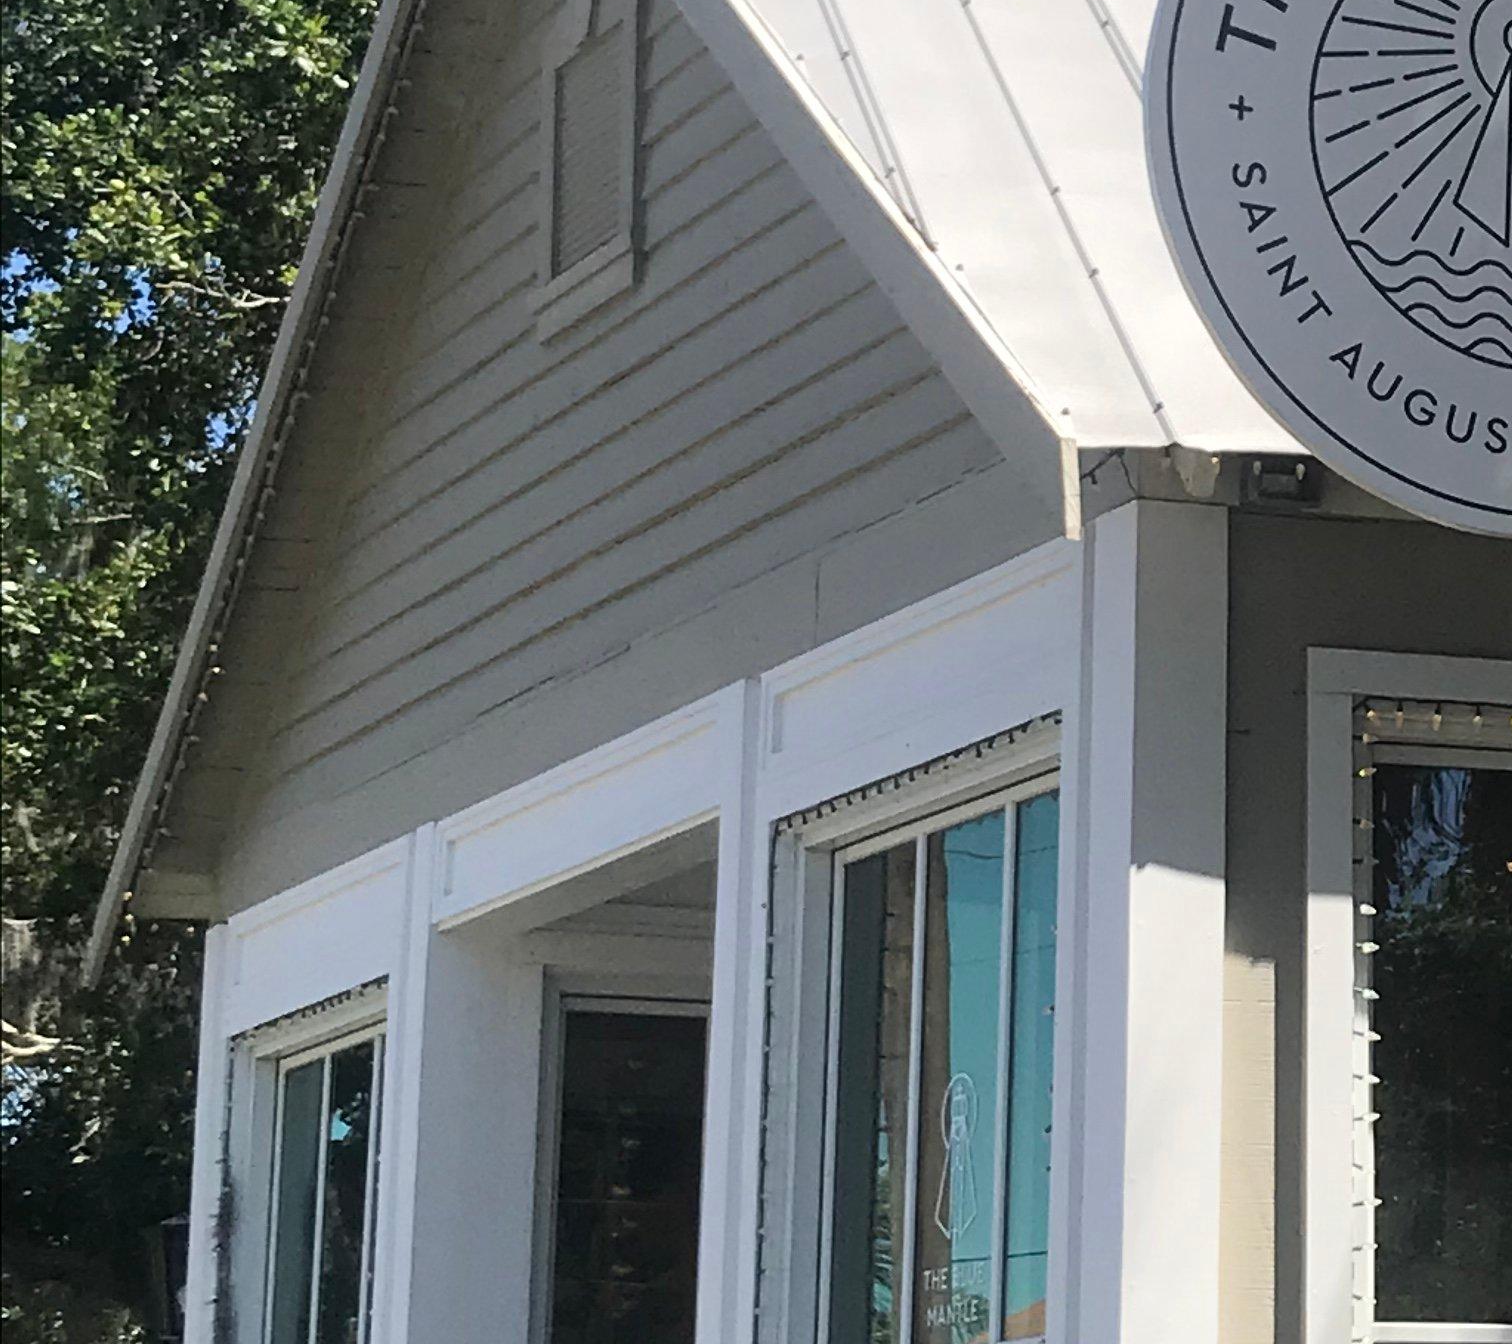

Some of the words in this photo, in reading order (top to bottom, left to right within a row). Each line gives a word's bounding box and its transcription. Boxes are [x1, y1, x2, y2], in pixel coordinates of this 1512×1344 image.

[1233, 162, 1332, 323] SAINT
[923, 1267, 948, 1291] THE
[926, 1299, 979, 1327] MANTLE
